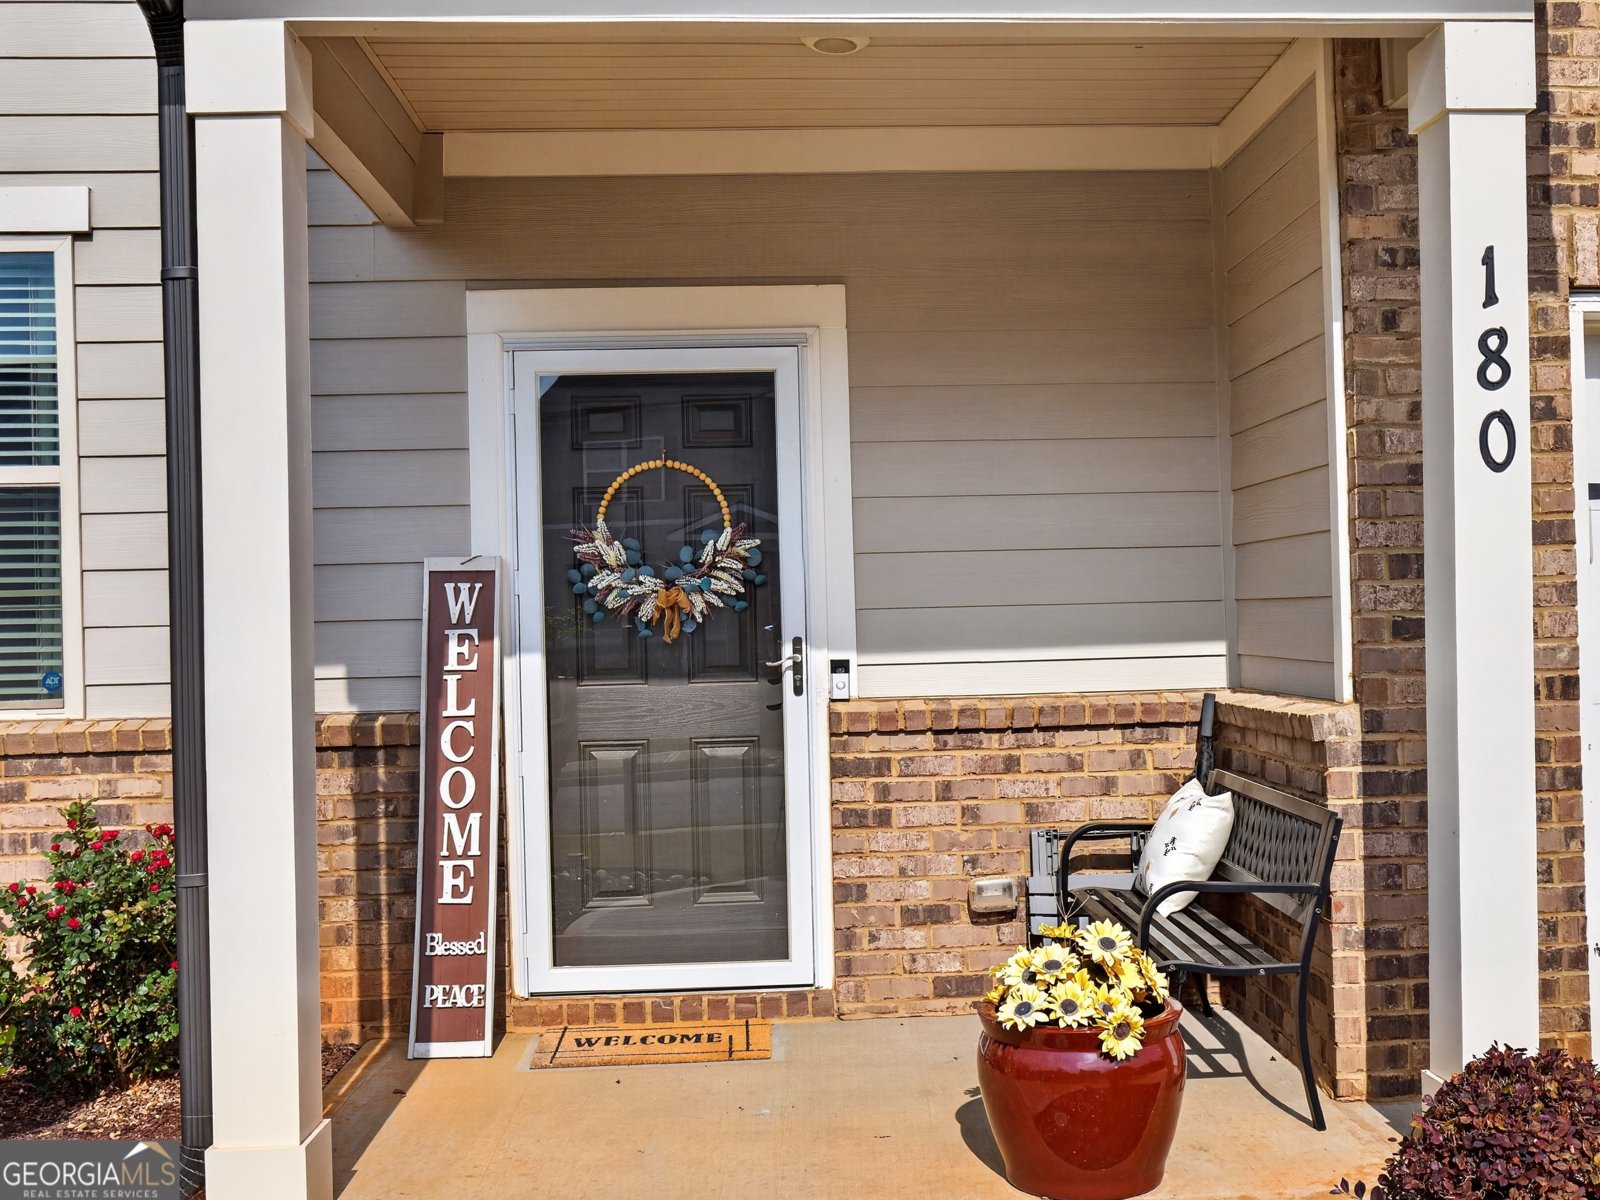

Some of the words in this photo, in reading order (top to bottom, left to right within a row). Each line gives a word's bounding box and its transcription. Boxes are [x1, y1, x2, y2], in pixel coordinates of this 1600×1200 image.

[1476, 245, 1517, 473] 180
[45, 676, 60, 685] ADT
[437, 582, 483, 904] WELCOME
[425, 931, 486, 956] Blessed
[423, 984, 485, 1008] PEACE
[574, 1032, 722, 1048] WELCOME
